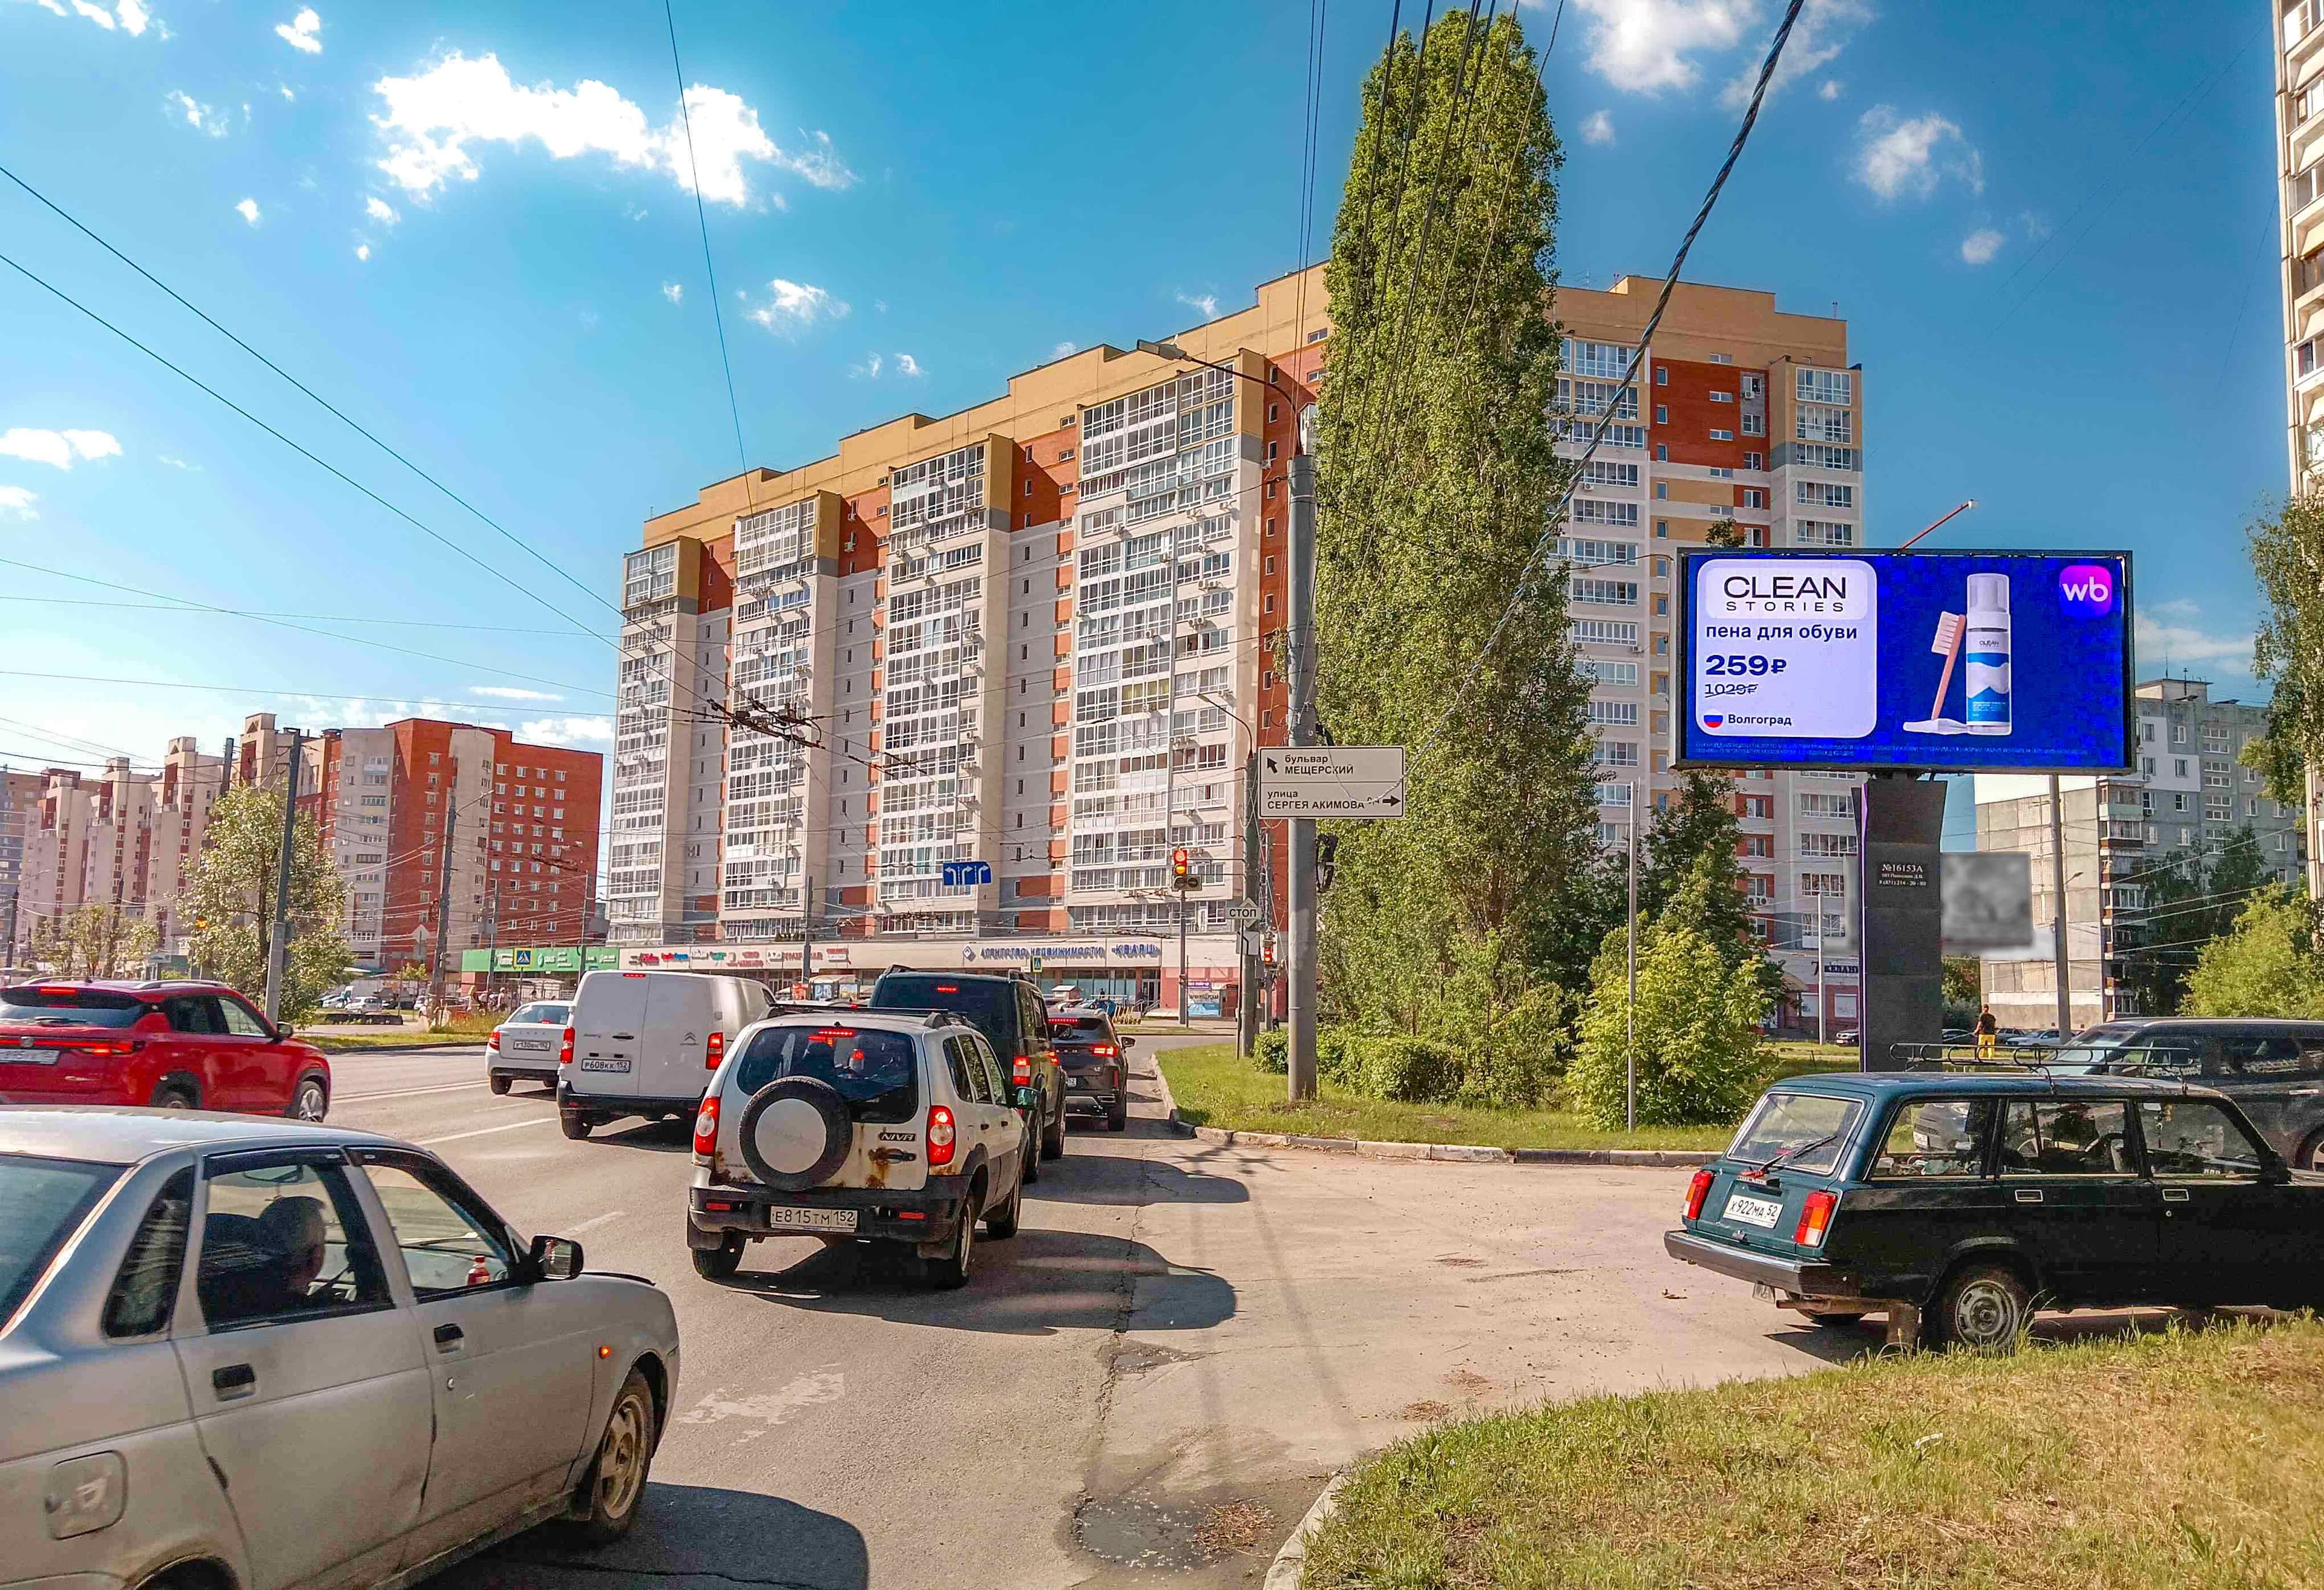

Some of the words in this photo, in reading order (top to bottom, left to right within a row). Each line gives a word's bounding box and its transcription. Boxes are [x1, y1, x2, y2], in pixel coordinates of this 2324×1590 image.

[1724, 576, 1846, 599] CLEAN
[2062, 579, 2109, 602] wb
[1726, 602, 1844, 612] STORIES
[1705, 626, 1753, 639] пена
[1758, 626, 1793, 641] для
[1799, 624, 1858, 642] обуви
[1705, 655, 1787, 676] 259₽
[1728, 714, 1792, 727] Волгоград
[1284, 754, 1328, 765] бульвар
[1284, 764, 1354, 776] МЕЩЕРСКИЙ
[1267, 791, 1298, 800] улица
[1267, 800, 1308, 810] СЕРГЕЯ
[1312, 800, 1365, 810] АКИМОВА
[1229, 909, 1256, 917] СТОП
[775, 1209, 830, 1225] Е815ТМ
[833, 1211, 854, 1222] 152
